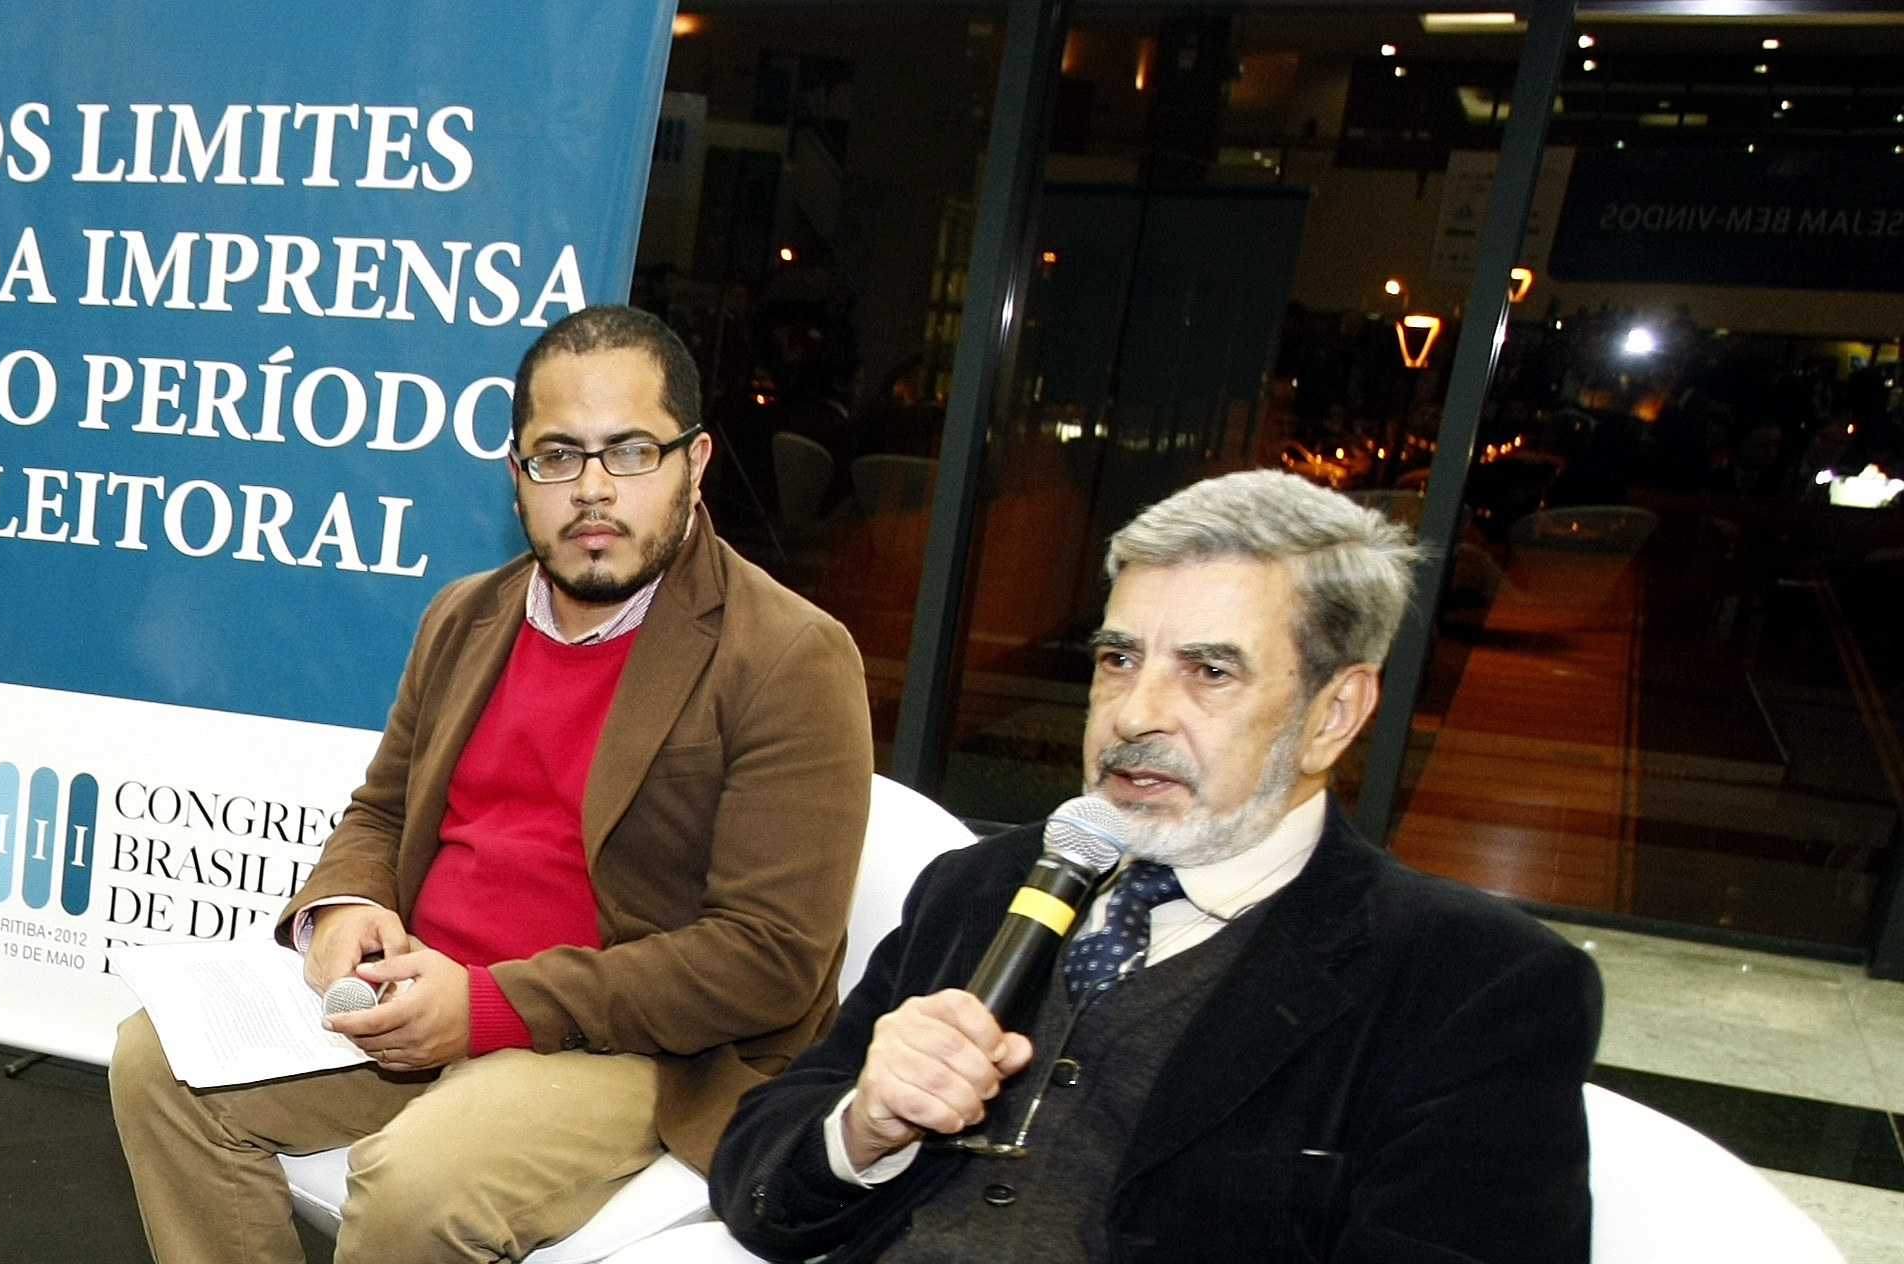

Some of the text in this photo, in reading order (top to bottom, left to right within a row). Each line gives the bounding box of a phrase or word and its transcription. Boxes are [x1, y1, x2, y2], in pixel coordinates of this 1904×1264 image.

[72, 103, 475, 192] LIMITES
[79, 229, 586, 328] IMPRENSA
[77, 346, 515, 460] PERÍODO
[22, 945, 42, 962] DE
[46, 949, 86, 970] MAIO
[105, 884, 270, 942] DE DI
